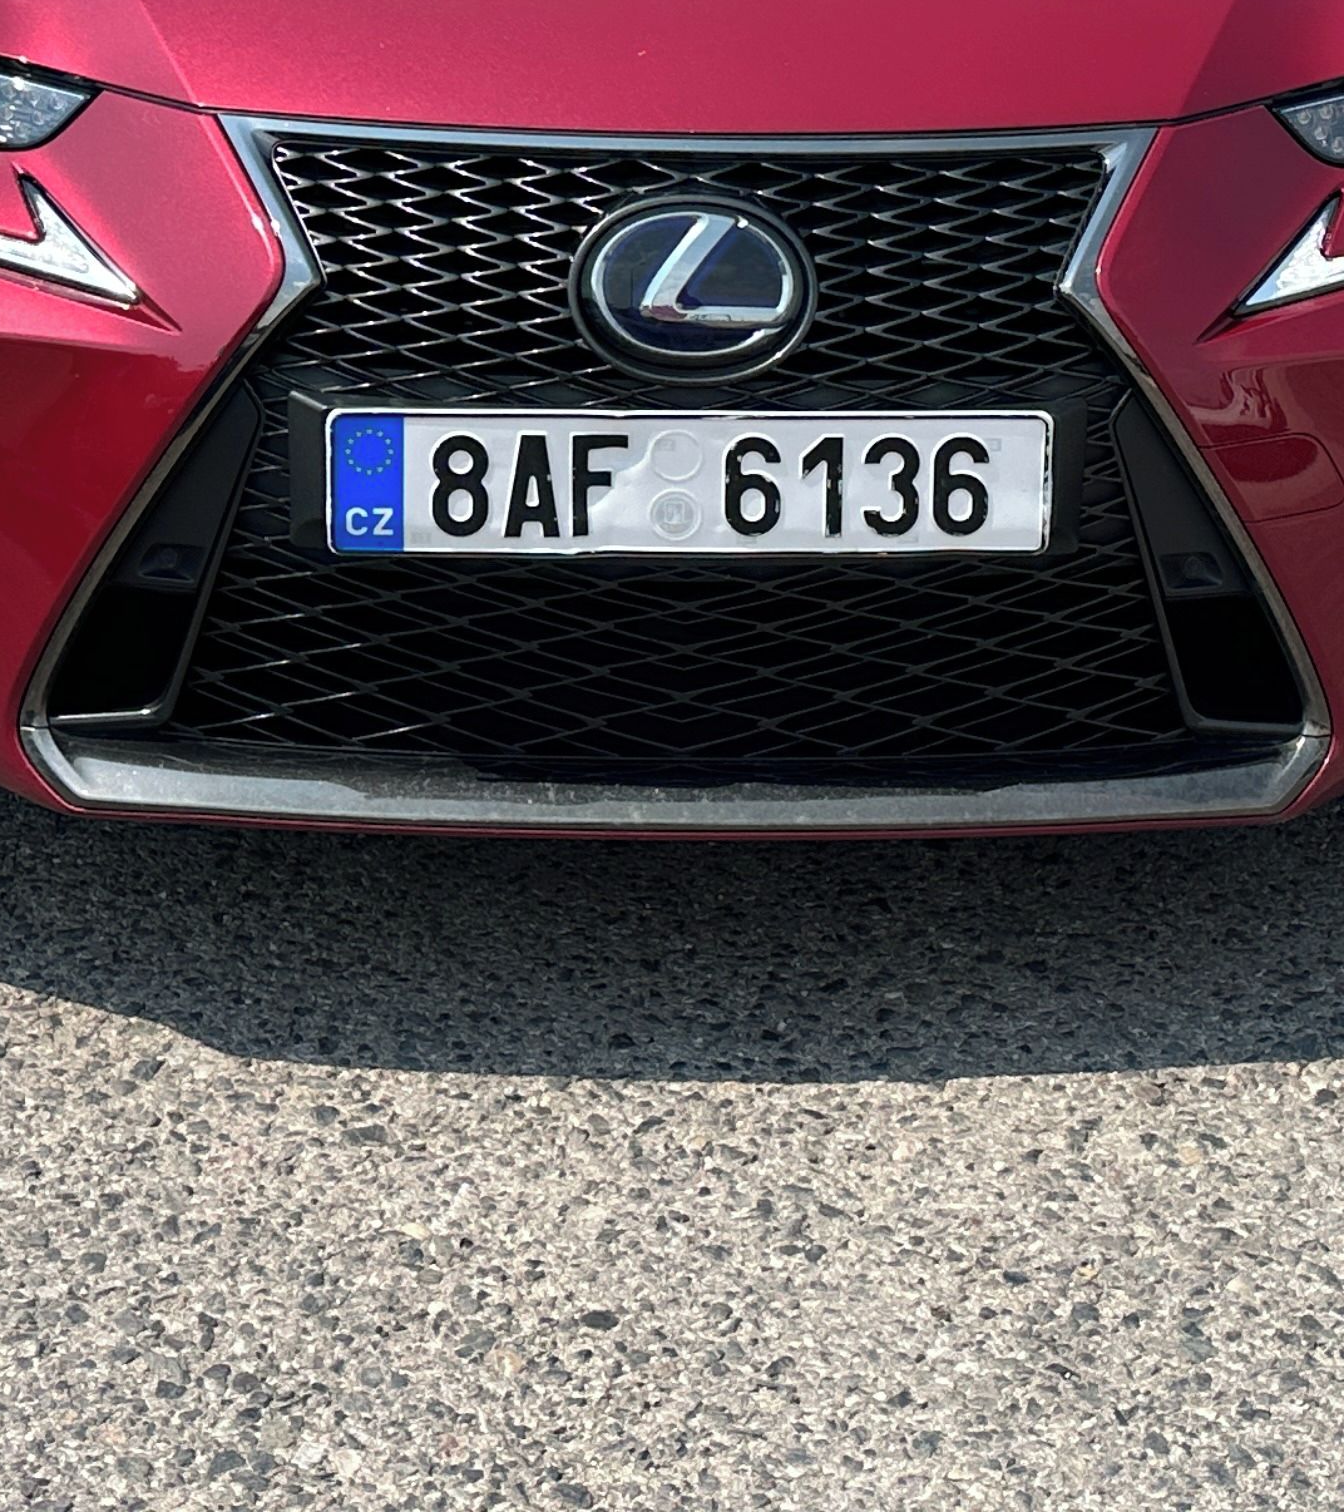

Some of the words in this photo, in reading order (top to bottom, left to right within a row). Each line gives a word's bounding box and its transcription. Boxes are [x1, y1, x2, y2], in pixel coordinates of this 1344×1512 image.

[346, 507, 395, 537] CZ
[432, 434, 629, 539] 8AF
[724, 436, 990, 538] 6136
